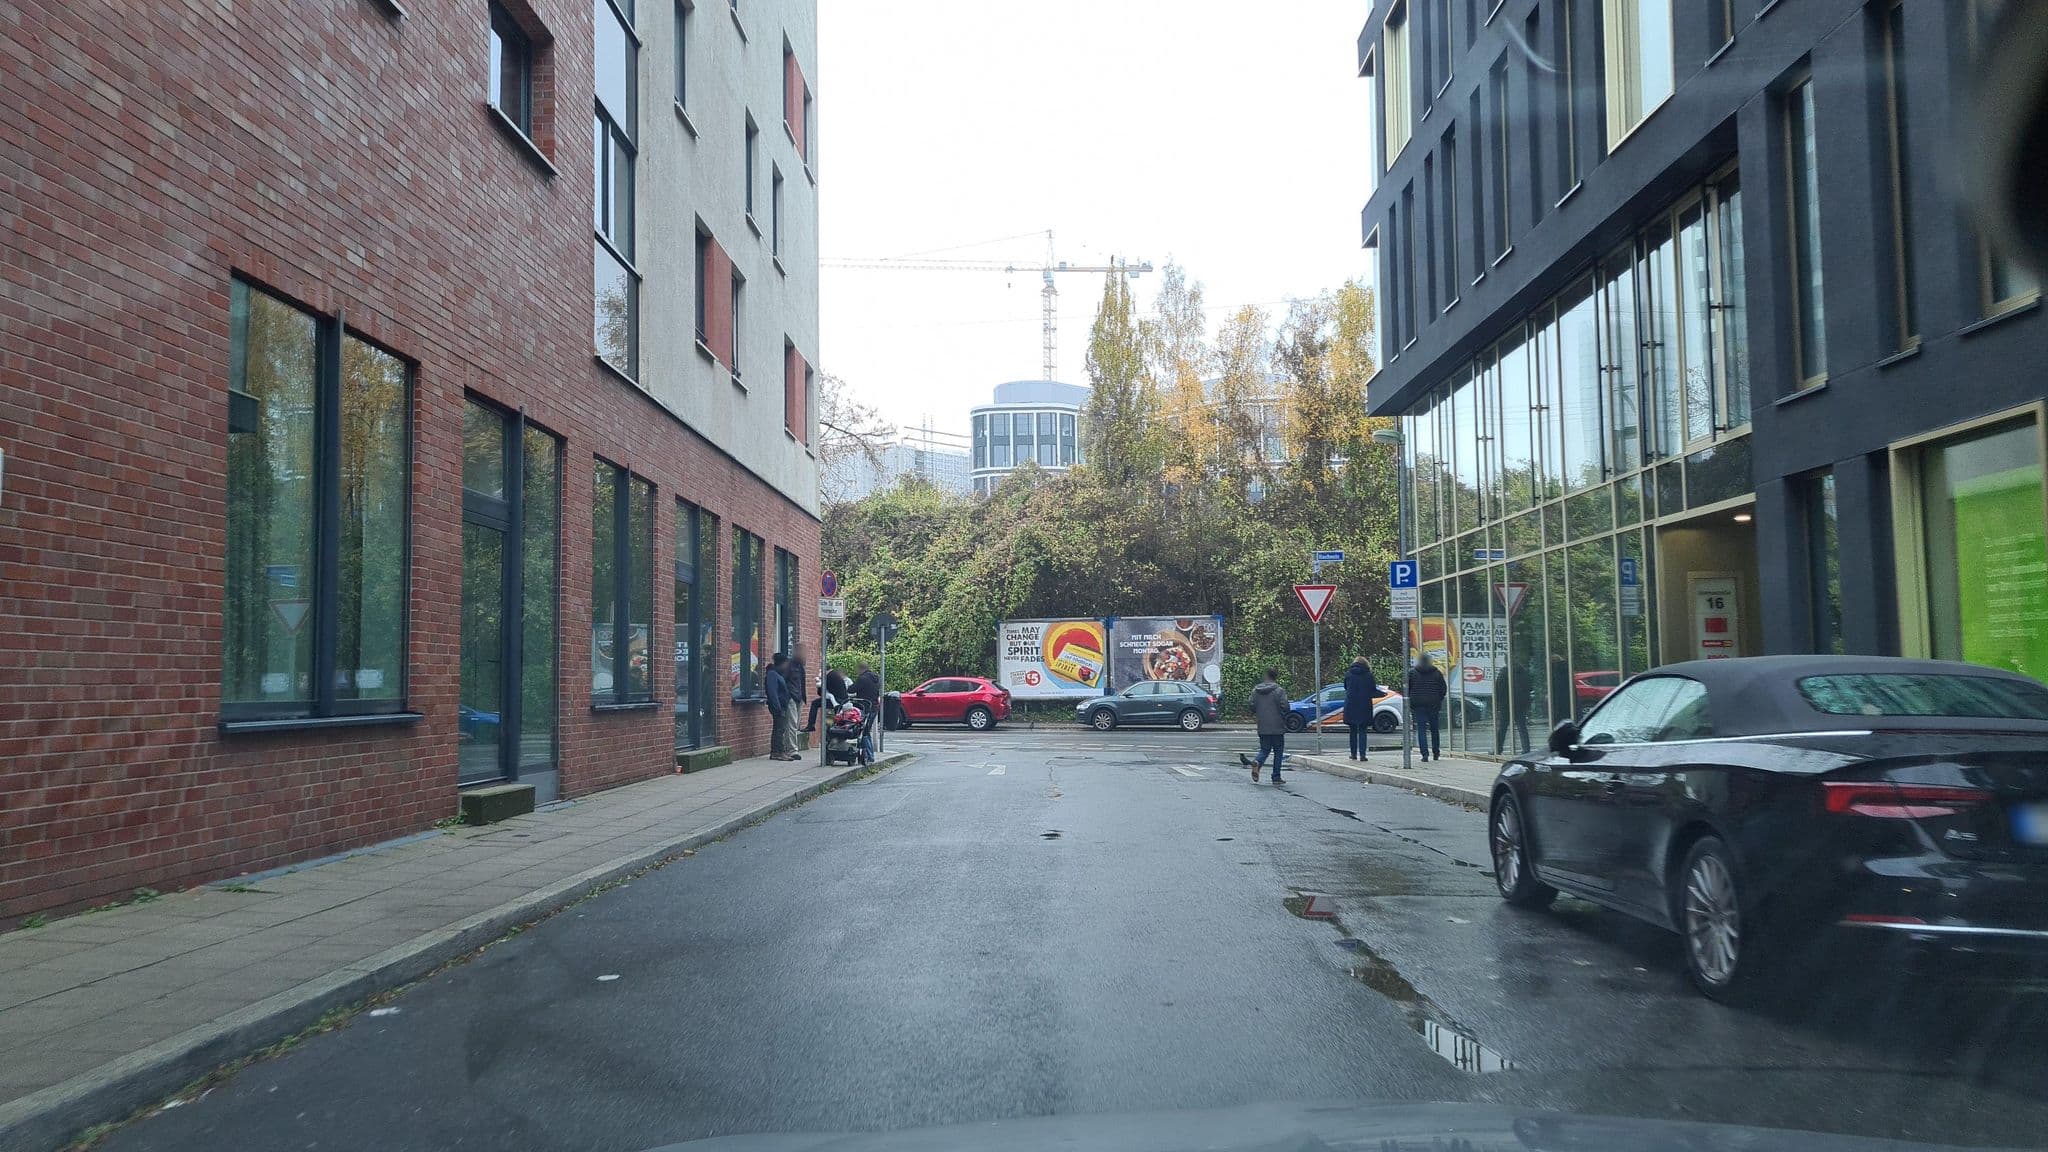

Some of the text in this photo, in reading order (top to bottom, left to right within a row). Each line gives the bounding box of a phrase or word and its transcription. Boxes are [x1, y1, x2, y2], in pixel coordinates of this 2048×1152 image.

[1396, 564, 1411, 585] P
[1706, 597, 1725, 609] 16
[1021, 626, 1041, 634] MAY
[1008, 646, 1041, 656] SPIRIT
